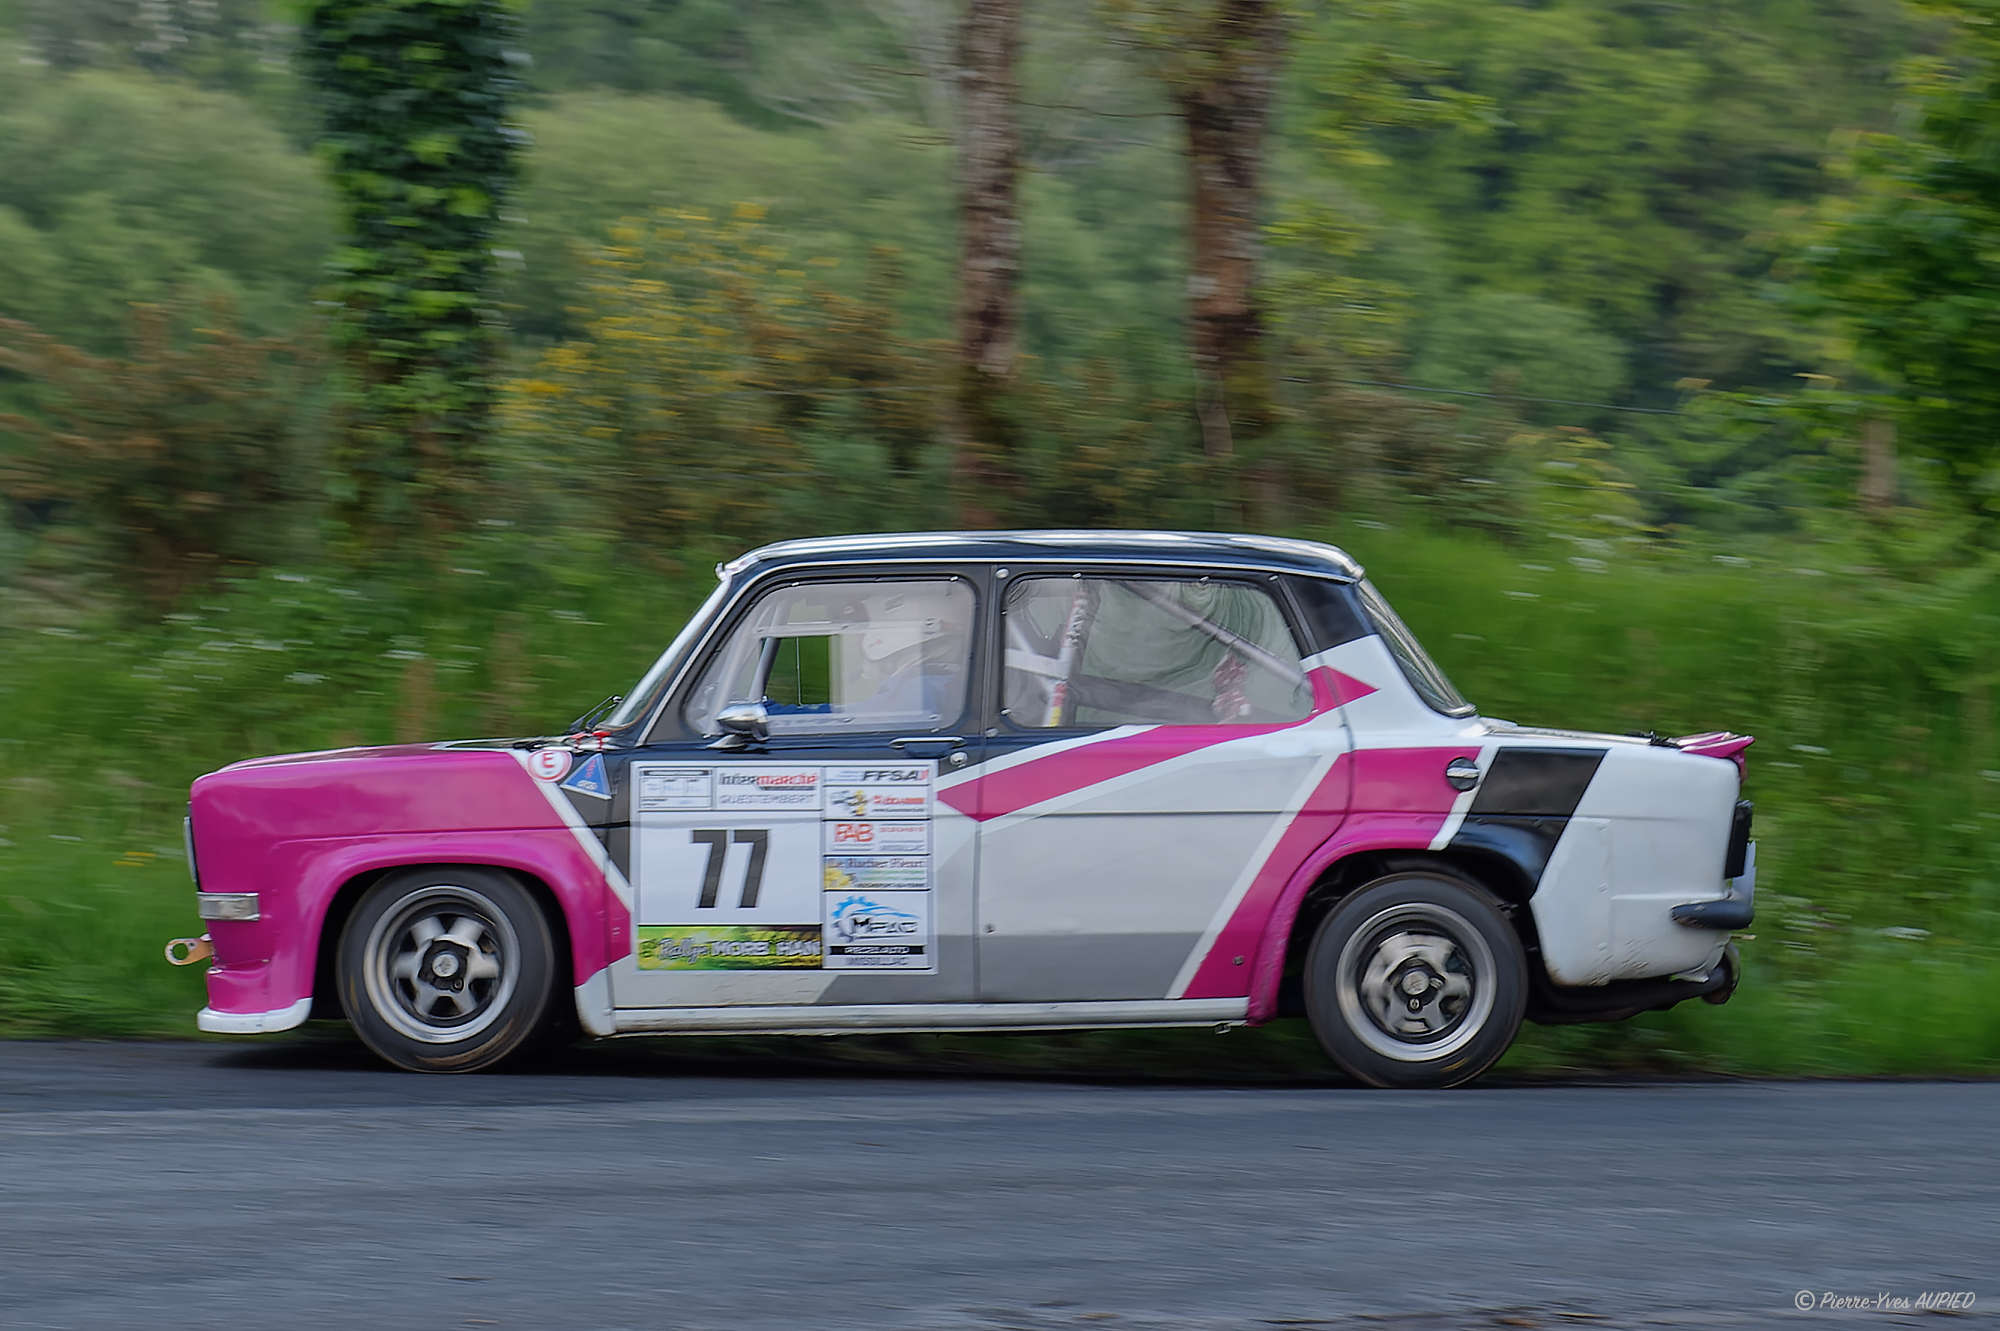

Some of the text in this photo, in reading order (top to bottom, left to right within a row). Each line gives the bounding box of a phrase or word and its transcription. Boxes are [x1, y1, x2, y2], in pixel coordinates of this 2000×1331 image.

[543, 752, 554, 768] E
[862, 769, 918, 781] FFSA
[691, 829, 769, 908] 77
